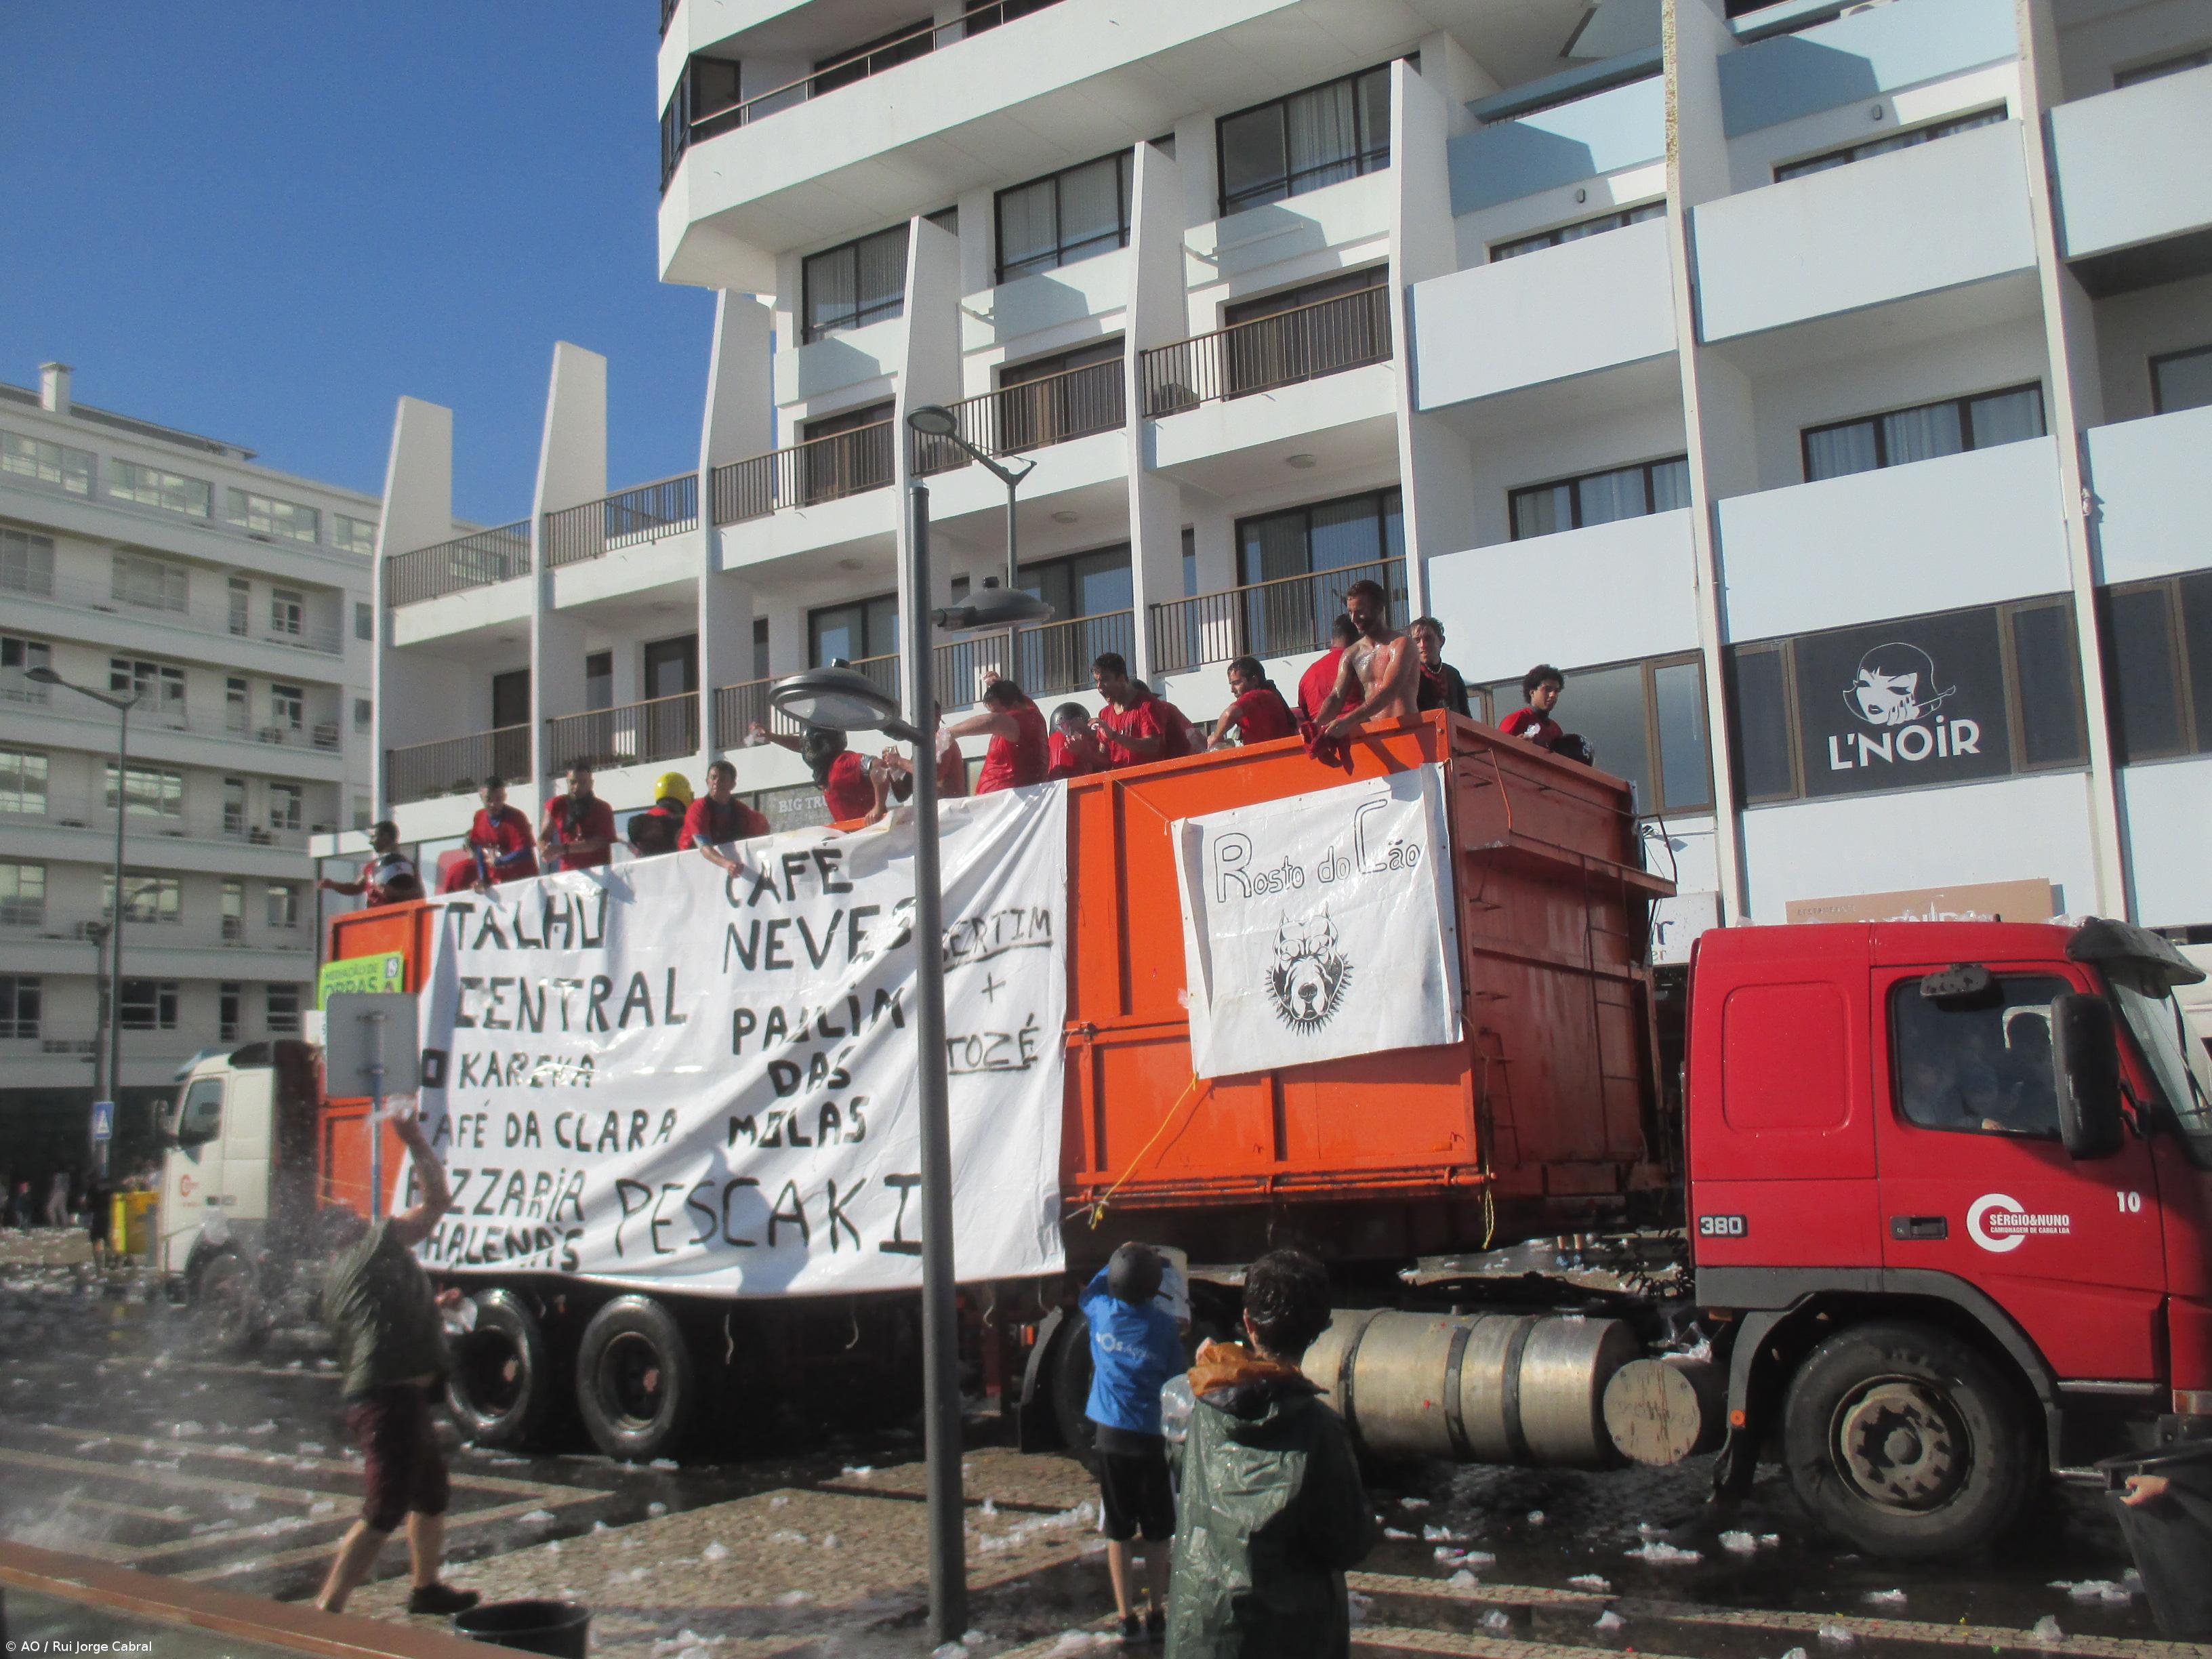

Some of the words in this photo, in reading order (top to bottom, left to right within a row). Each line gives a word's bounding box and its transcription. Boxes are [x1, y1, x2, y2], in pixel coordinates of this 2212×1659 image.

[779, 798, 802, 813] BIG
[1214, 832, 1305, 903] Rosto
[1317, 846, 1351, 882] do
[1355, 798, 1421, 874] Cão
[943, 906, 1052, 961] ERTIM
[455, 967, 688, 1033] CENTRAL
[946, 1012, 1040, 1068] TOZÉ
[767, 1046, 856, 1097] DAS
[418, 1099, 489, 1148] AFÉ
[505, 1111, 541, 1148] DA
[554, 1108, 678, 1153] CLARA
[615, 1173, 922, 1258] PESCAKI
[1700, 1216, 1742, 1234] 380
[2116, 1191, 2141, 1212] 10
